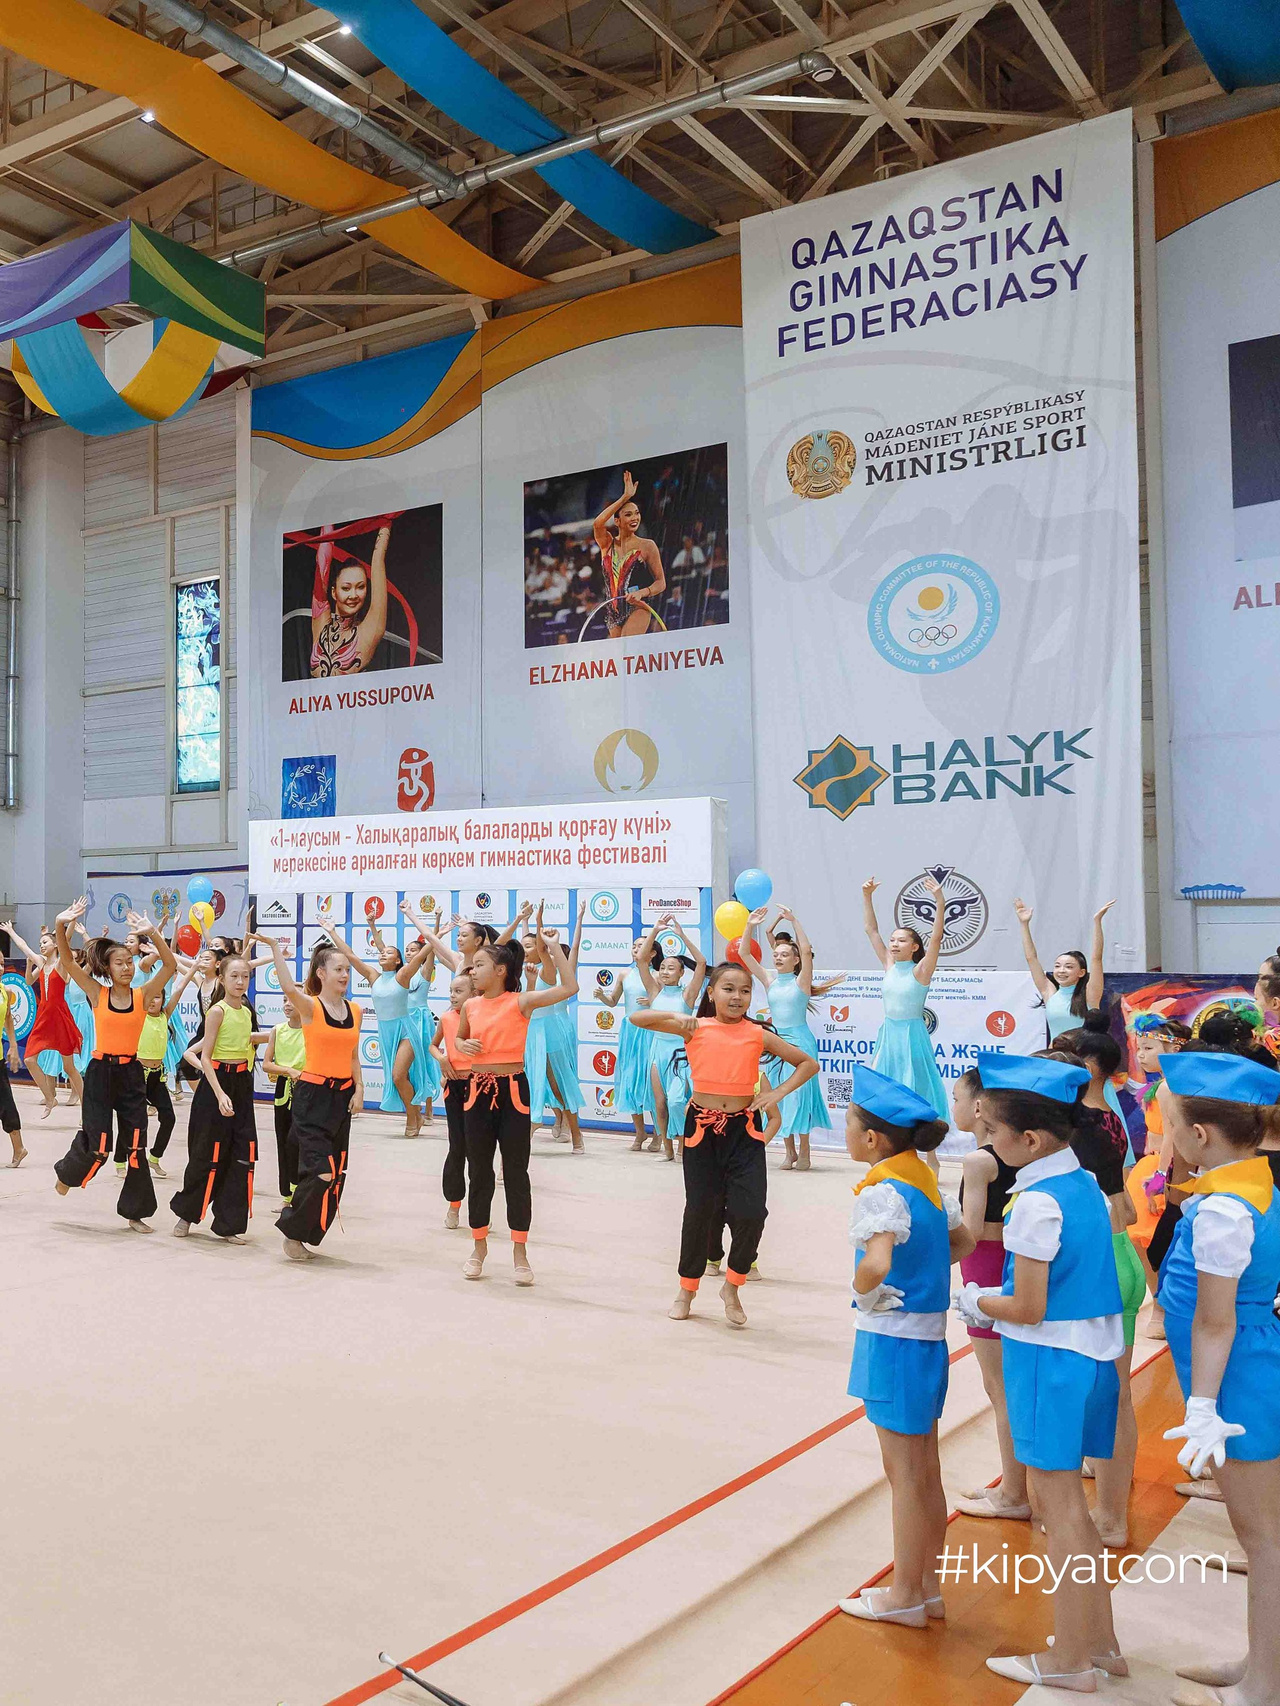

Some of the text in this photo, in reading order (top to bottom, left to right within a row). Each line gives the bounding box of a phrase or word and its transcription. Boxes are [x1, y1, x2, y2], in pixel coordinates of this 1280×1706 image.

[790, 167, 1065, 271] QAZAQSTAN
[788, 215, 1071, 314] GIMNASTIKA
[777, 253, 1089, 358] FEDERACIASY
[864, 389, 1086, 444] QAZAQSTAN RESPÝBLIKASY
[864, 405, 1086, 461] MÁDENIET JÁNE SPORT
[864, 425, 1087, 487] MINISTRLIGI
[873, 559, 993, 667] NATIONAL OLYMPIC COMMITTEE OF THE REPUBLIC OF KAZAKHSTAN
[528, 645, 725, 686] ELZHANA TANIYEVA
[288, 682, 435, 715] ALIYA YUSSUPOVA
[891, 727, 1095, 774] HALYK
[892, 762, 1077, 806] BANK
[270, 827, 341, 852] «1-маусым
[355, 823, 460, 849] Халықаралық
[464, 818, 553, 844] балаларды
[558, 816, 618, 842] қорғау
[623, 810, 672, 841] күні»
[272, 840, 668, 878] мерекесіне арналған көркем гимнастика фестивалі
[648, 899, 692, 907] ProDanceShop
[594, 942, 629, 950] AMANAT
